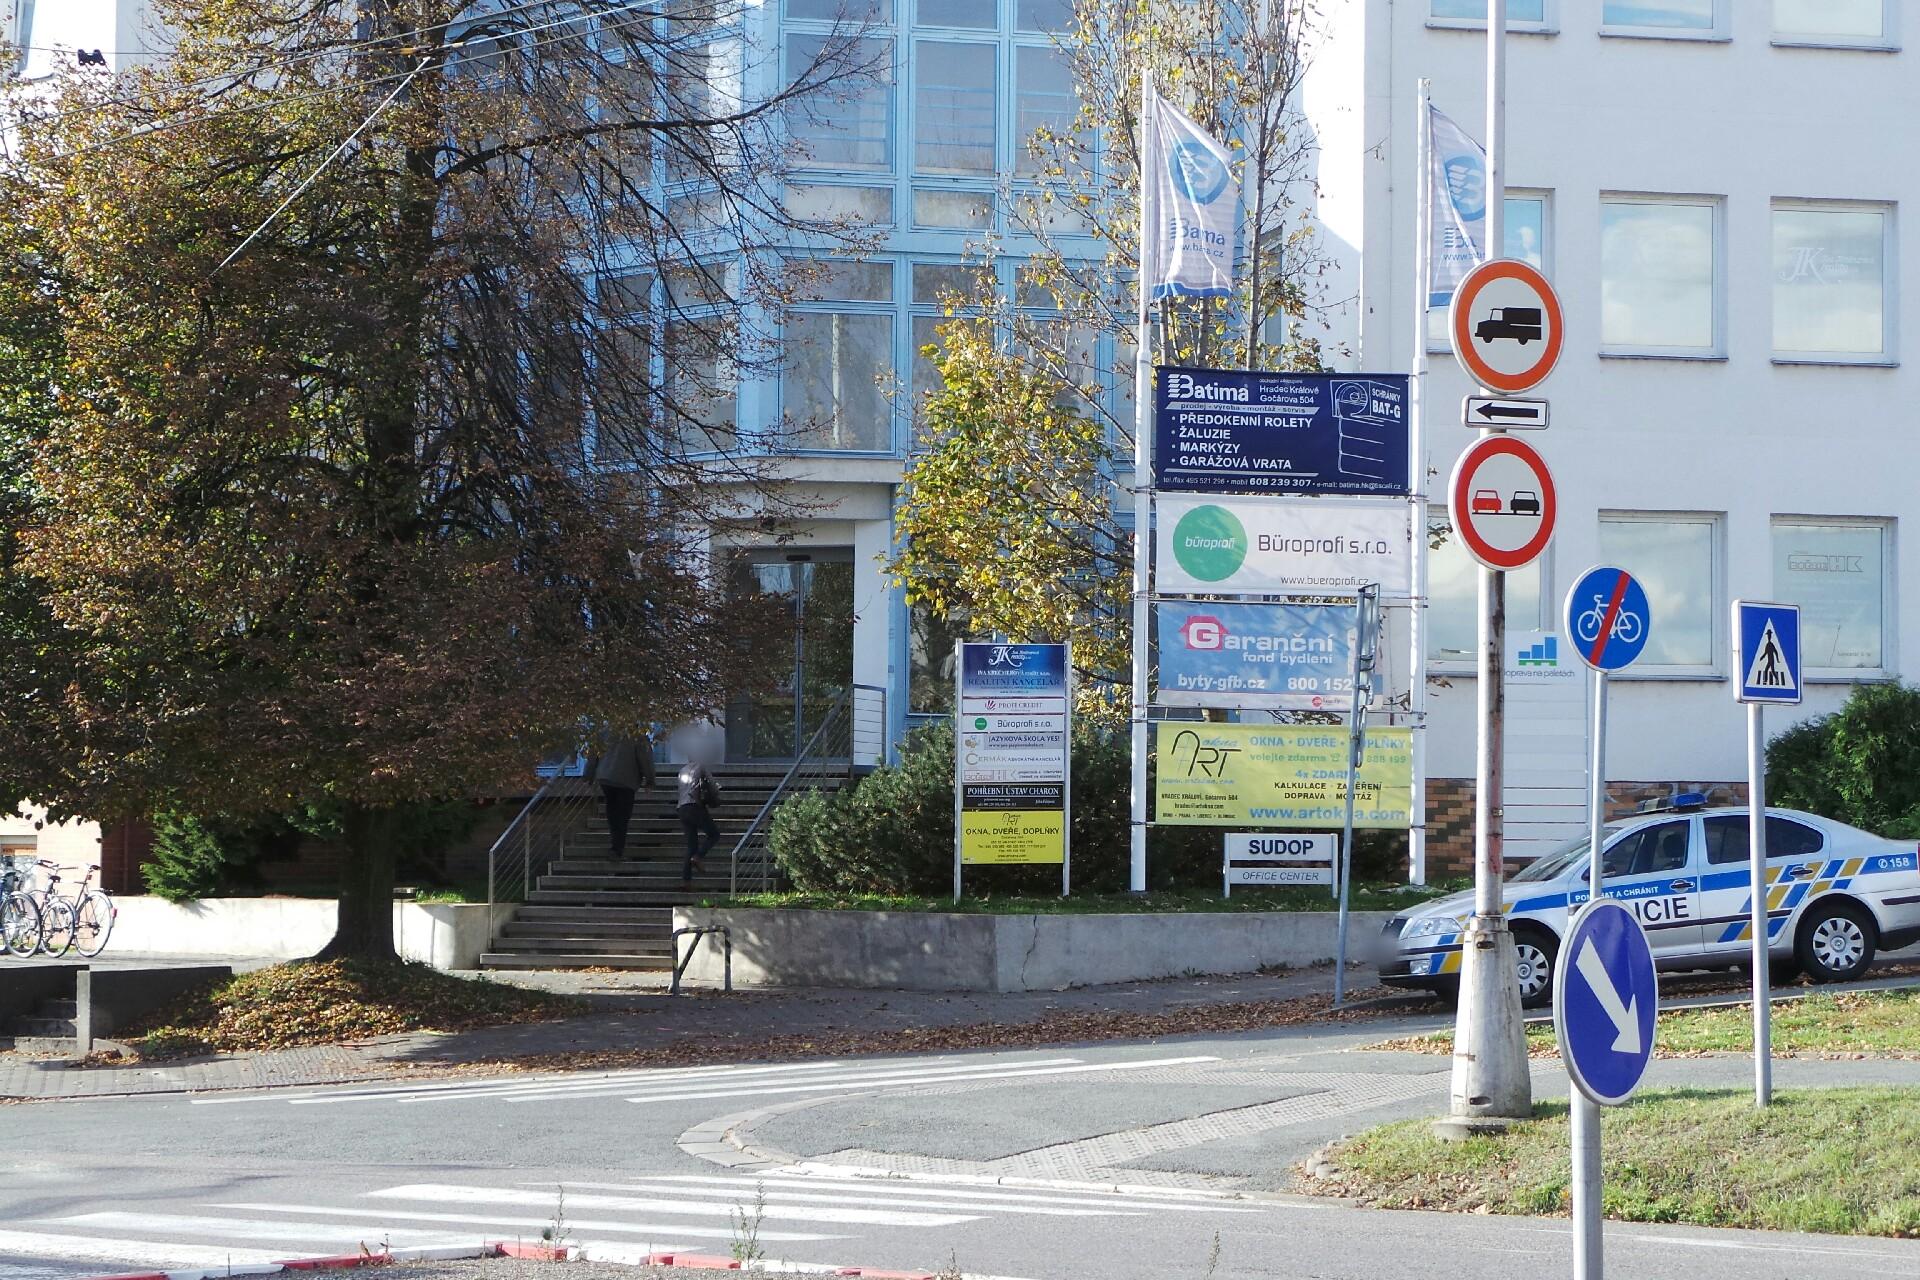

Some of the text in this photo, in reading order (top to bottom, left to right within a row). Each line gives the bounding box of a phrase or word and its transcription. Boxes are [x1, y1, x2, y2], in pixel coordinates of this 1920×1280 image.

[1168, 374, 1249, 402] Batima
[1259, 385, 1320, 395] Hradec Králové
[1372, 387, 1401, 402] SCHRÁNKY
[1181, 403, 1206, 411] prodej
[1213, 404, 1240, 412] výroba
[1372, 400, 1401, 419] BAT-G
[1179, 412, 1313, 428] PŘEDOKENNÍ ROLETY
[1179, 425, 1231, 439] ŽALUZIE
[1180, 441, 1240, 454] MARKÝZY
[1180, 455, 1292, 470] GARÁŽOVÁ VRATA
[1249, 478, 1269, 486] 608
[1270, 478, 1290, 487] 239
[1292, 479, 1311, 487] 307
[1185, 536, 1235, 549] büroprofi
[1258, 534, 1392, 556] Büroprofi s.r.o.
[1281, 575, 1369, 586] www.bueroprofi.cz
[1188, 622, 1334, 653] Garanční
[1243, 652, 1333, 665] fond bydlení
[1504, 670, 1532, 678] oprava
[1178, 673, 1265, 690] byty-gfb.cz
[1287, 677, 1352, 691] 800 152
[997, 720, 1033, 729] Büroprofi
[1250, 735, 1406, 749] OKNA DVEŘE PLŇKY
[1288, 753, 1326, 762] zdarma
[967, 785, 1059, 795] POHŘEBNÍ ÚSTAV CHARON
[1274, 781, 1382, 791] KALKULACE ZAĚŘENÍ
[1284, 792, 1325, 800] DOPRAVA
[1250, 805, 1406, 821] www.artoka.com
[965, 826, 1060, 836] OKNA, DVEŘE, DOPLŇKY
[1249, 839, 1314, 855] SUDOP
[1889, 857, 1910, 868] 158
[1243, 872, 1319, 881] OFFICE CENTER
[1623, 886, 1659, 897] CHRÁNIT
[1634, 897, 1689, 922] ICIE
